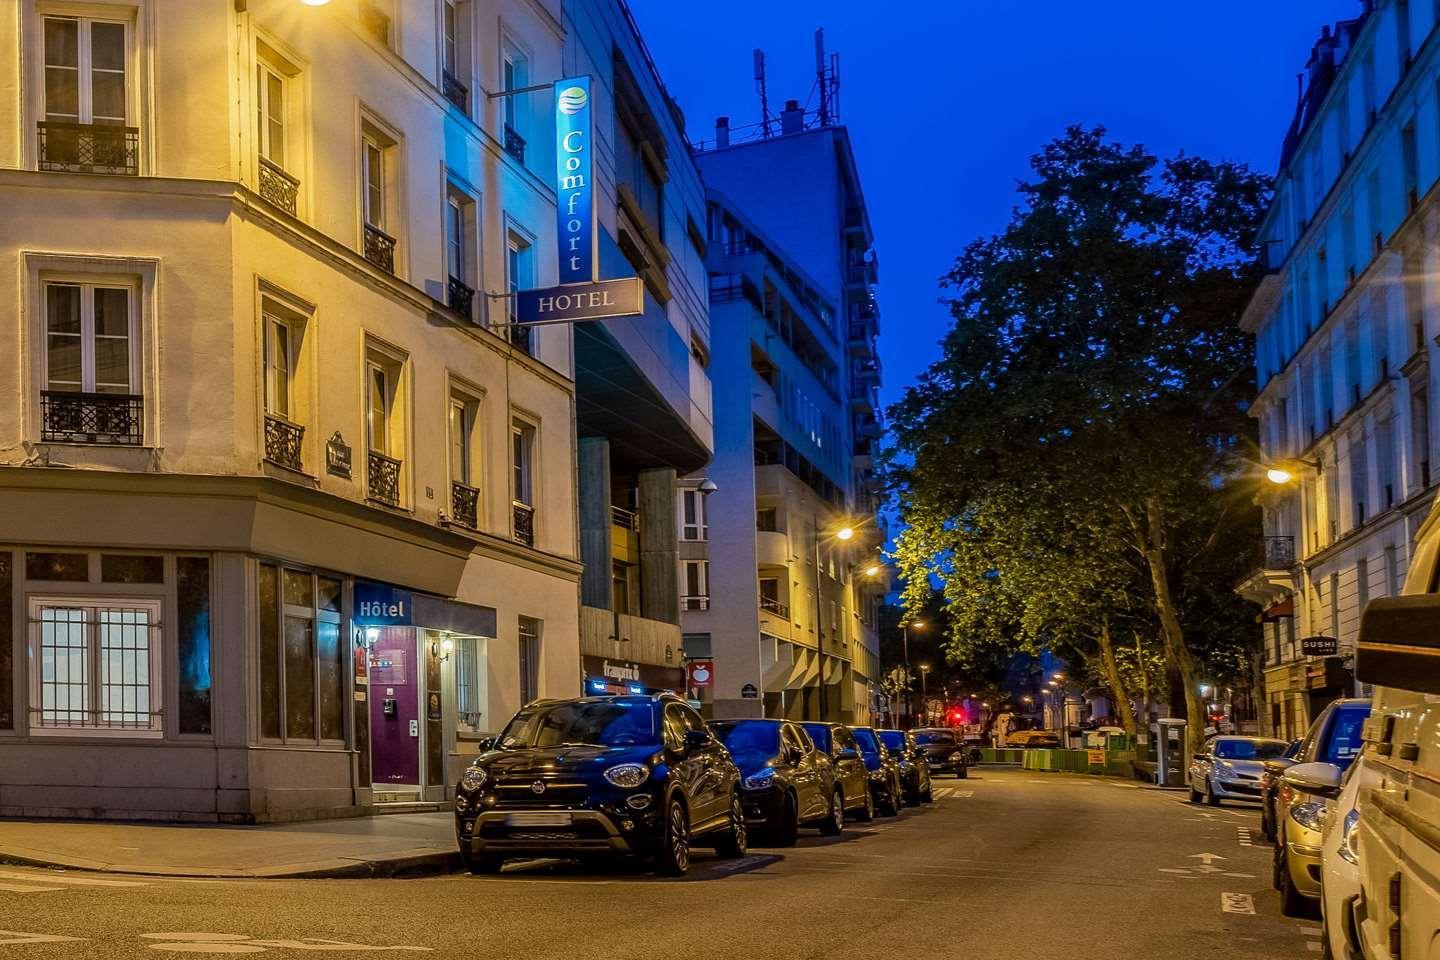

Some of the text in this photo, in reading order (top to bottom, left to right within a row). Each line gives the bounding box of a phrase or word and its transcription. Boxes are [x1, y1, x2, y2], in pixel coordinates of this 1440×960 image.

[562, 130, 586, 271] Comfort
[538, 290, 615, 313] HOTEL
[360, 601, 404, 617] Hôtel
